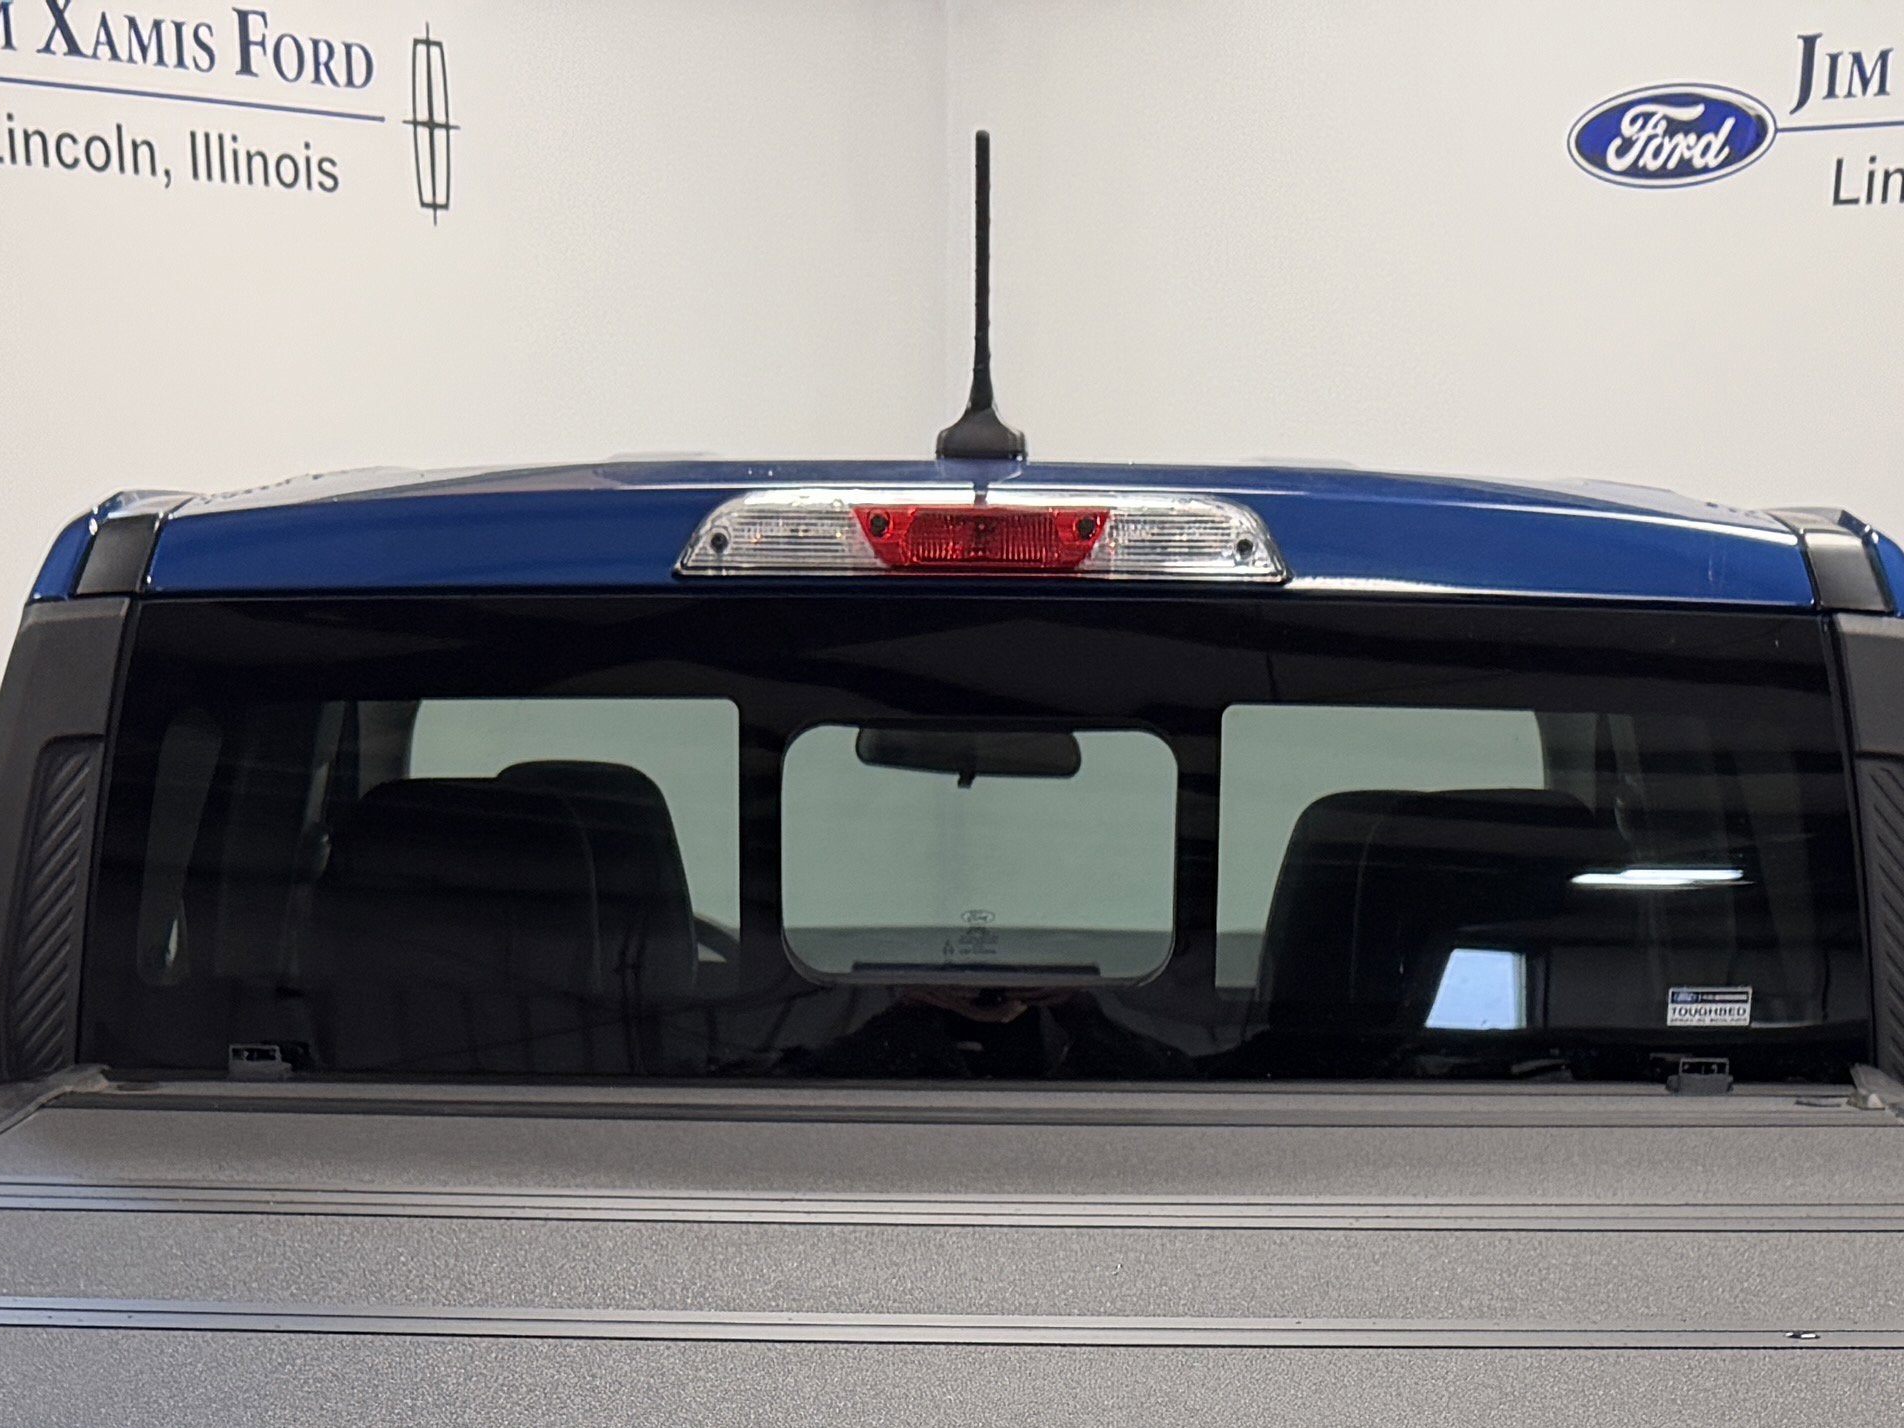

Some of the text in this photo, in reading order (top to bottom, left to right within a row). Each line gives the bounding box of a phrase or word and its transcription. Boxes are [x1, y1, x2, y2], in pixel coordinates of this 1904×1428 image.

[35, 0, 216, 73] XAMIS
[231, 6, 374, 90] FORD
[1788, 32, 1894, 116] JIM
[188, 130, 341, 194] Illinois
[1605, 102, 1737, 172] Ford
